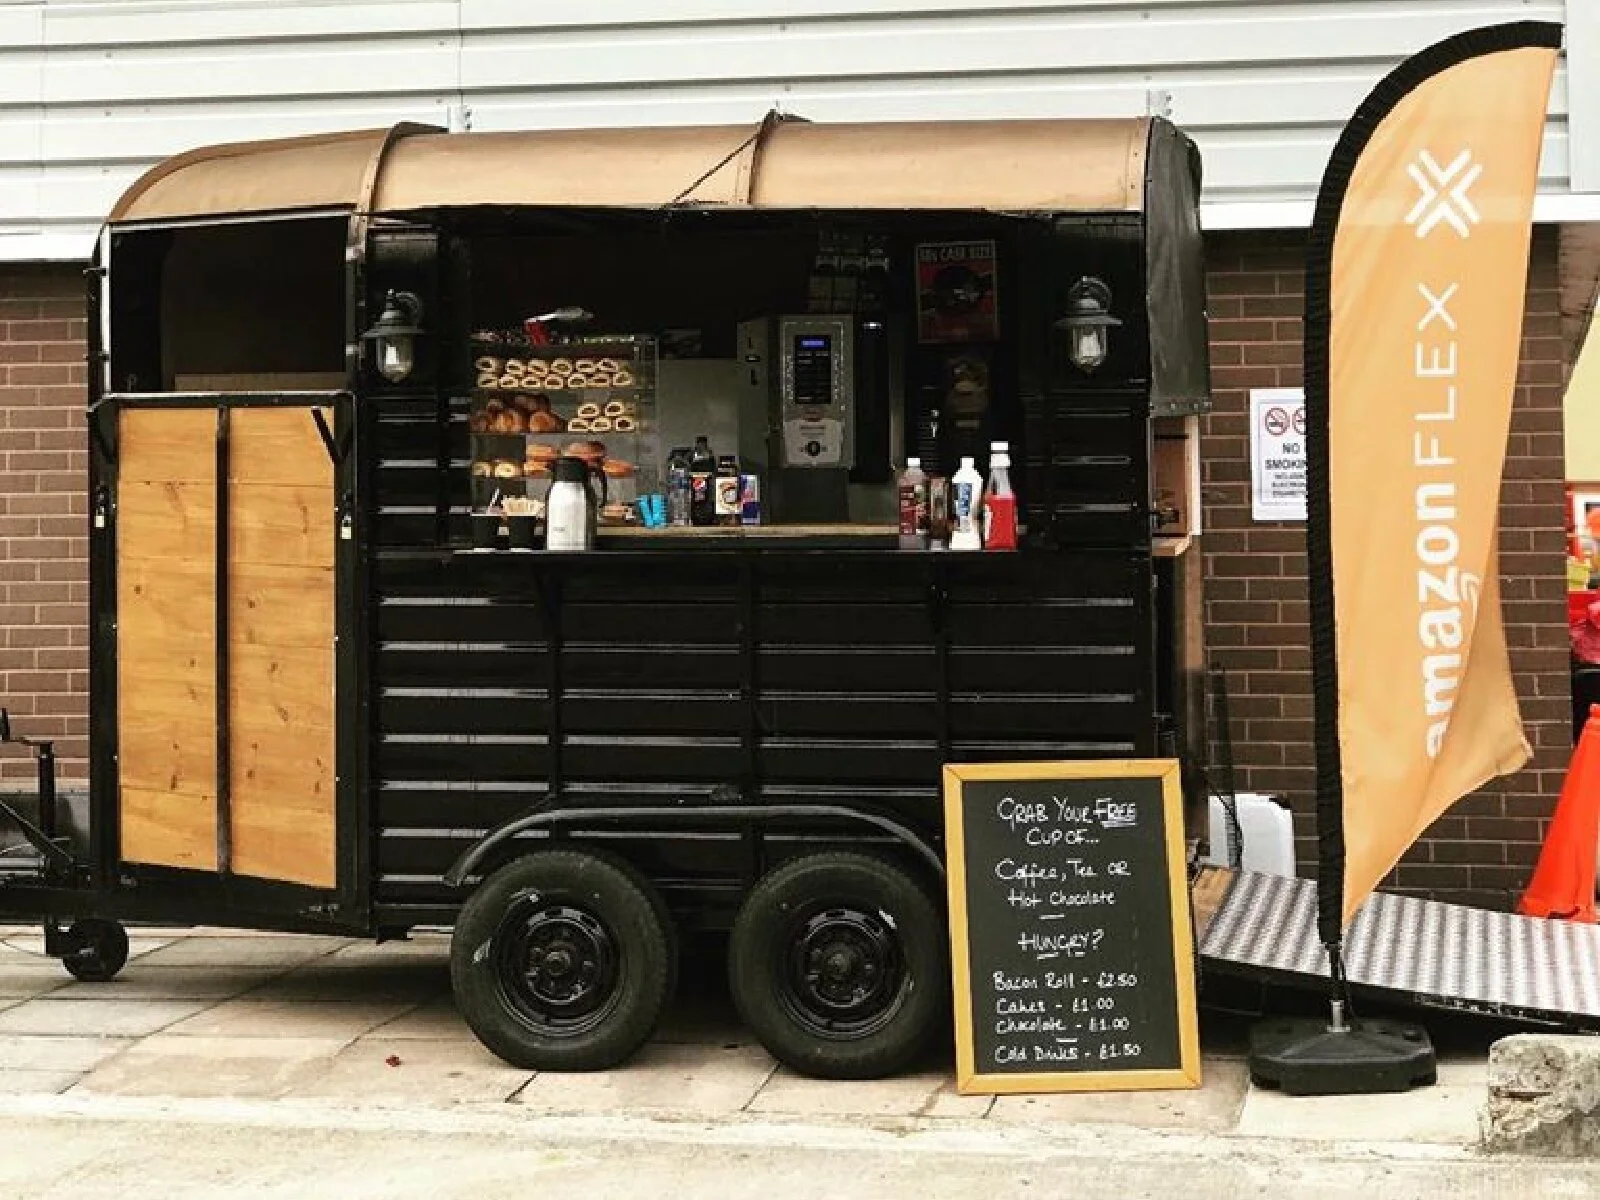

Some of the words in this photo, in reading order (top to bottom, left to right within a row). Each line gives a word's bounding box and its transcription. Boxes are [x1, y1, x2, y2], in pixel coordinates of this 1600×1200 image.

[1264, 459, 1307, 470] SMOKIN
[997, 797, 1049, 831] GRAB
[1008, 888, 1042, 909] Hot
[1017, 928, 1105, 957] HUNGRY?
[993, 970, 1038, 991] Bacon
[1044, 971, 1075, 989] Roll
[996, 997, 1046, 1014] Cakes
[994, 1045, 1028, 1064] Cold
[1033, 1045, 1079, 1061] Drinks
